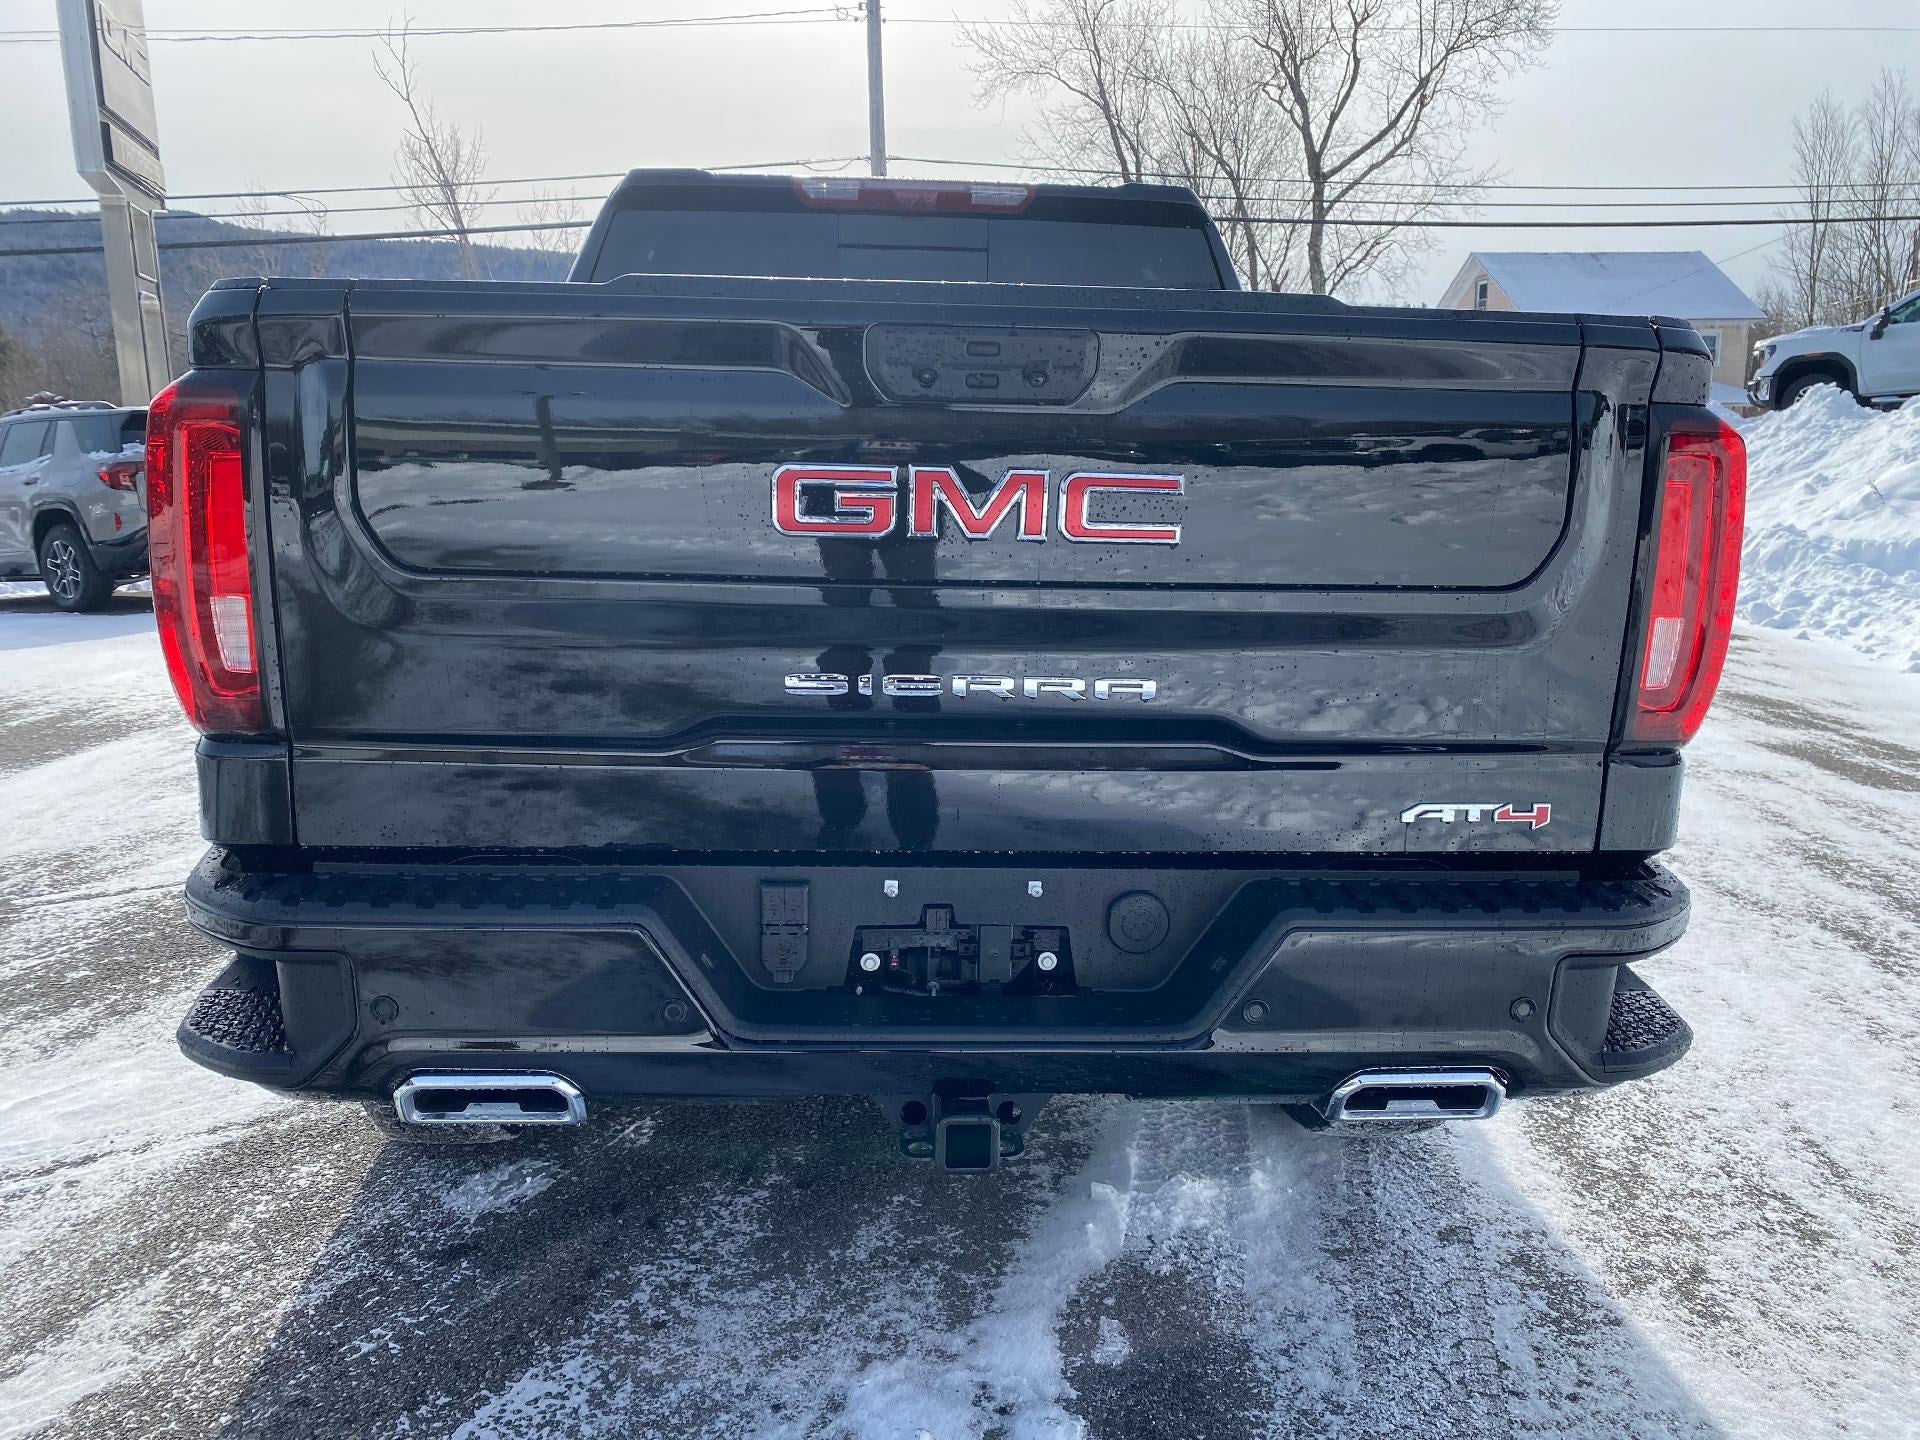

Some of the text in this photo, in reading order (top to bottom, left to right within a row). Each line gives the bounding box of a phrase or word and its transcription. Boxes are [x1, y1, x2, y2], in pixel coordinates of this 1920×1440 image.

[771, 463, 1186, 545] GMC
[784, 673, 1157, 701] SIERRA
[1400, 802, 1552, 830] AT4
